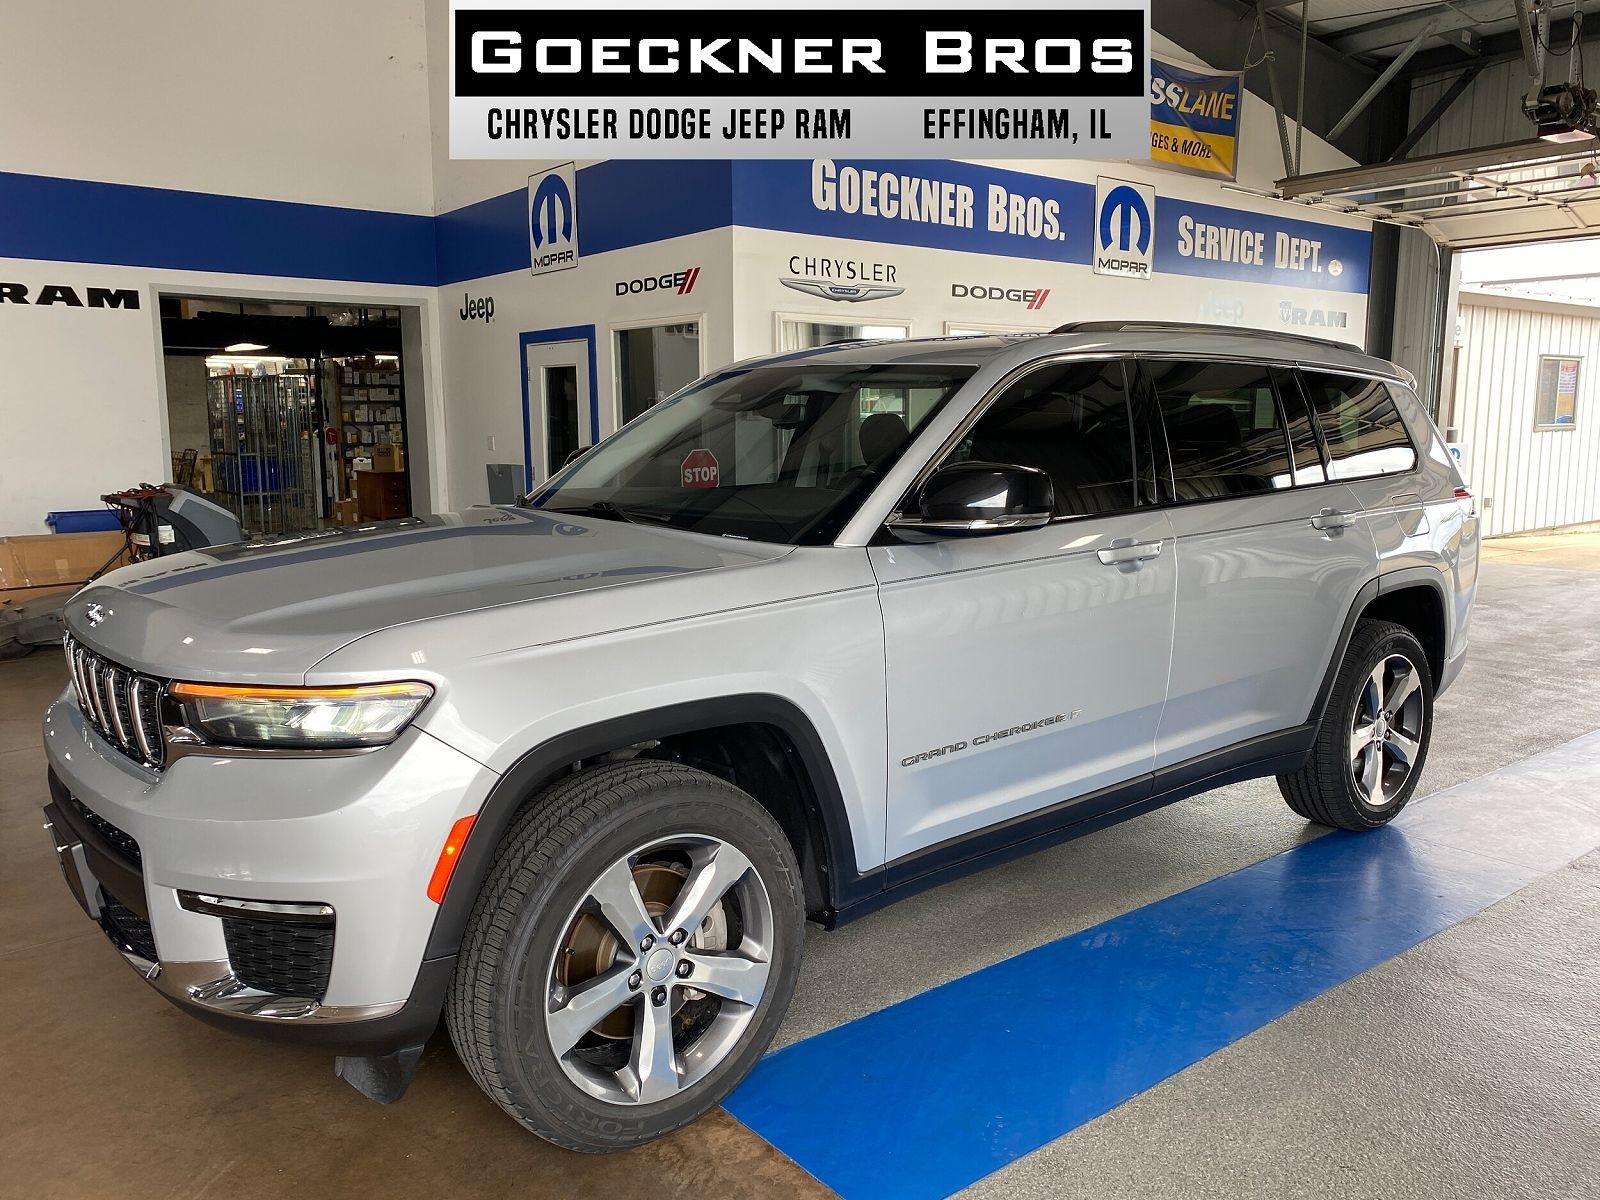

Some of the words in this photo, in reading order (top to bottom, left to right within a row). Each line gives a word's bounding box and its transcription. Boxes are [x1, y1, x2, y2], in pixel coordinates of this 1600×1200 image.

[1151, 78, 1235, 120] SSLANE
[1151, 132, 1170, 150] GES
[1171, 138, 1179, 153] &
[1181, 140, 1212, 159] MORE
[811, 159, 974, 229] GOECKNER
[987, 184, 1066, 241] BROS.
[1177, 215, 1265, 266] SERVICE
[1274, 231, 1322, 274] DEPT.
[534, 250, 574, 268] MOPAR
[789, 255, 897, 283] CHRYSLER
[1098, 257, 1148, 274] MOPAR
[0, 282, 140, 310] RAM
[615, 271, 688, 296] DODGE
[951, 283, 1036, 302] DODGE
[459, 293, 495, 323] Jeep
[1292, 307, 1348, 328] RAM
[684, 466, 717, 483] STOP
[901, 741, 968, 768] GRAND
[972, 713, 1067, 746] CHEROKEE
